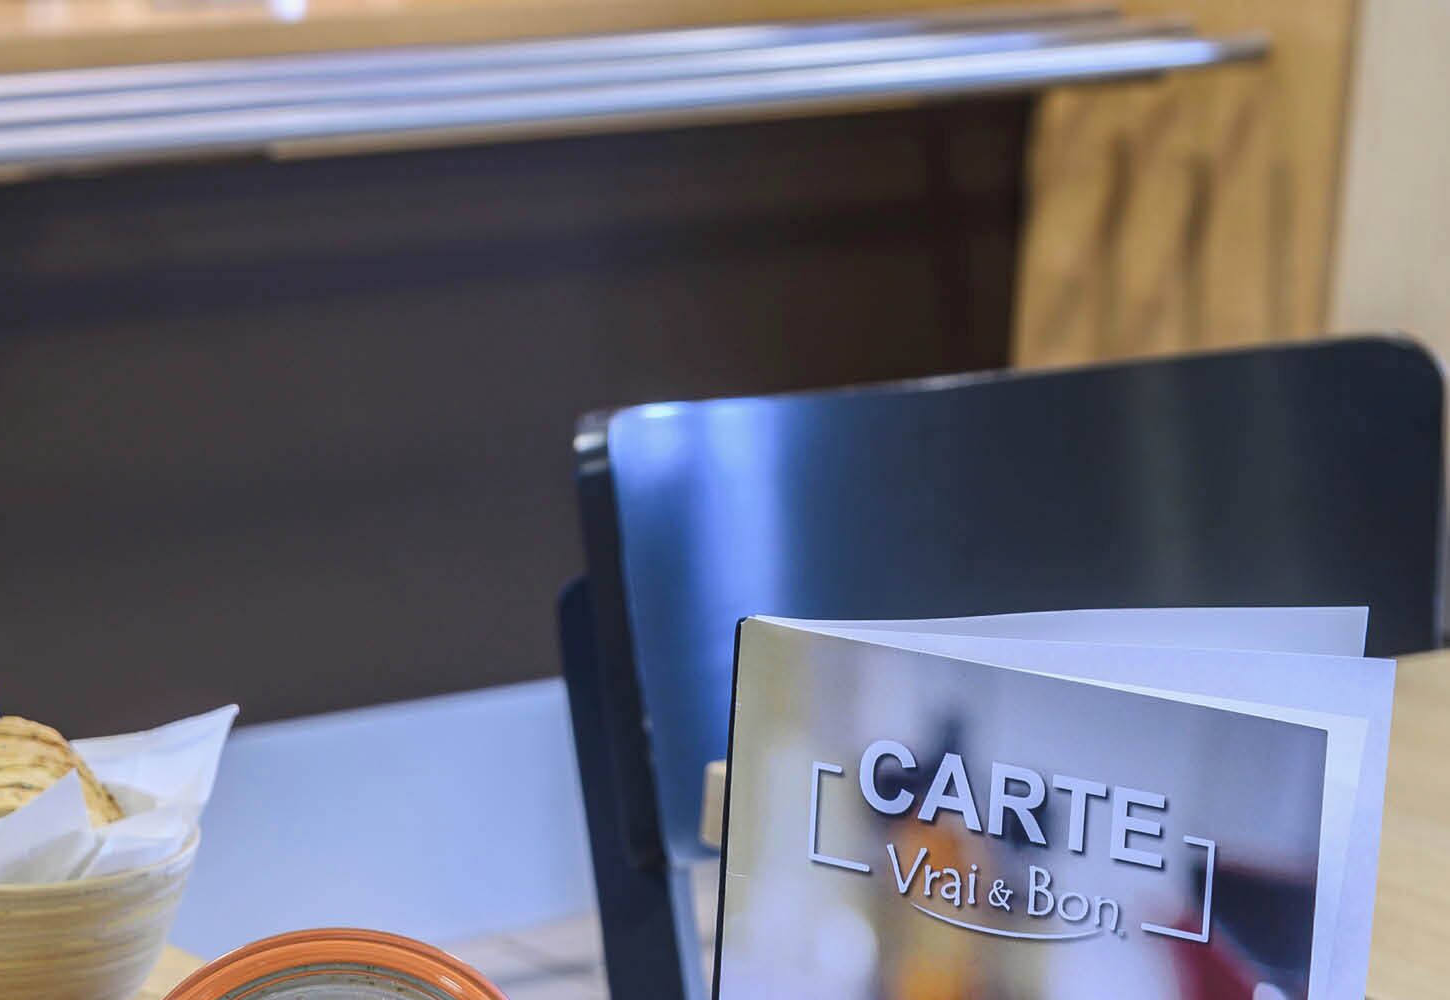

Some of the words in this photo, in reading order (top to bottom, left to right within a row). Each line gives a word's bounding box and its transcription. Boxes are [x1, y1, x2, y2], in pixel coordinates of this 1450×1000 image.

[859, 740, 1165, 868] CARTE
[886, 843, 978, 907] Vrai
[989, 879, 1013, 912] &
[1028, 865, 1119, 931] Bon
